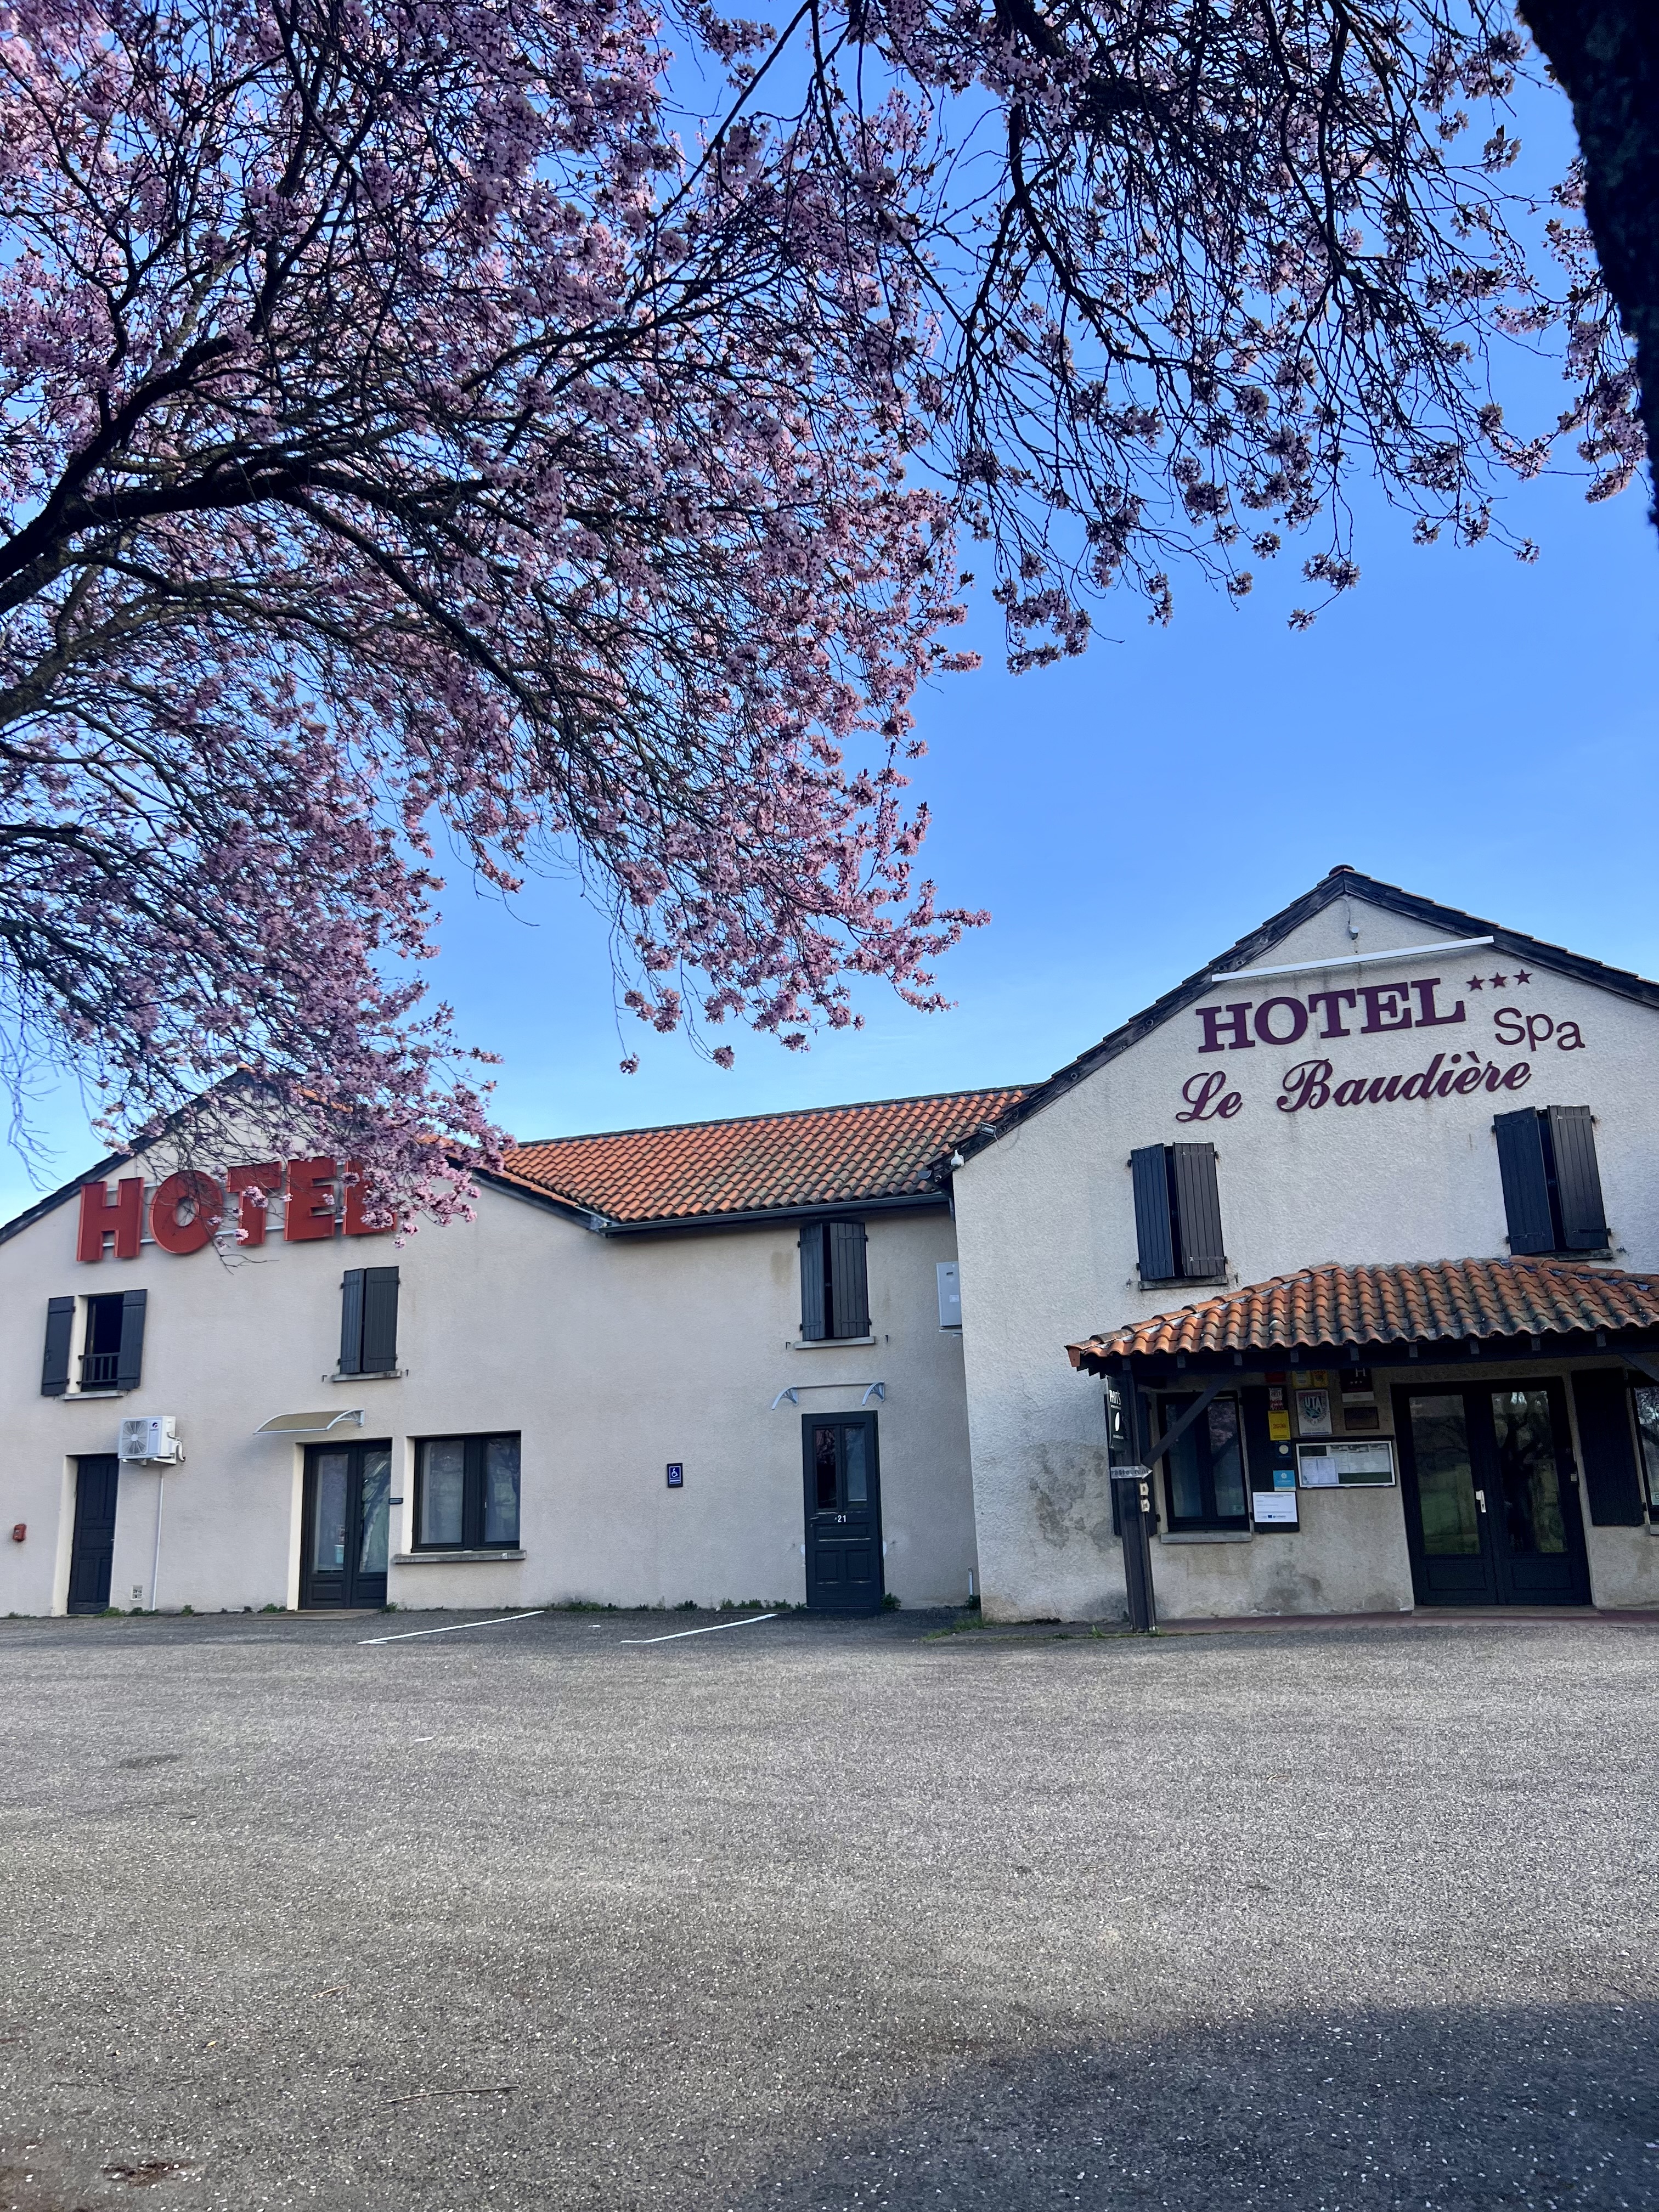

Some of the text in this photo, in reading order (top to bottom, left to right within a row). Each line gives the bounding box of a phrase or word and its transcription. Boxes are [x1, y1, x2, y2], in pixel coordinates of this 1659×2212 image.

[1195, 977, 1466, 1053] HOTEL
[1494, 1007, 1586, 1052] Spa
[1175, 1050, 1532, 1123] Le Baudière
